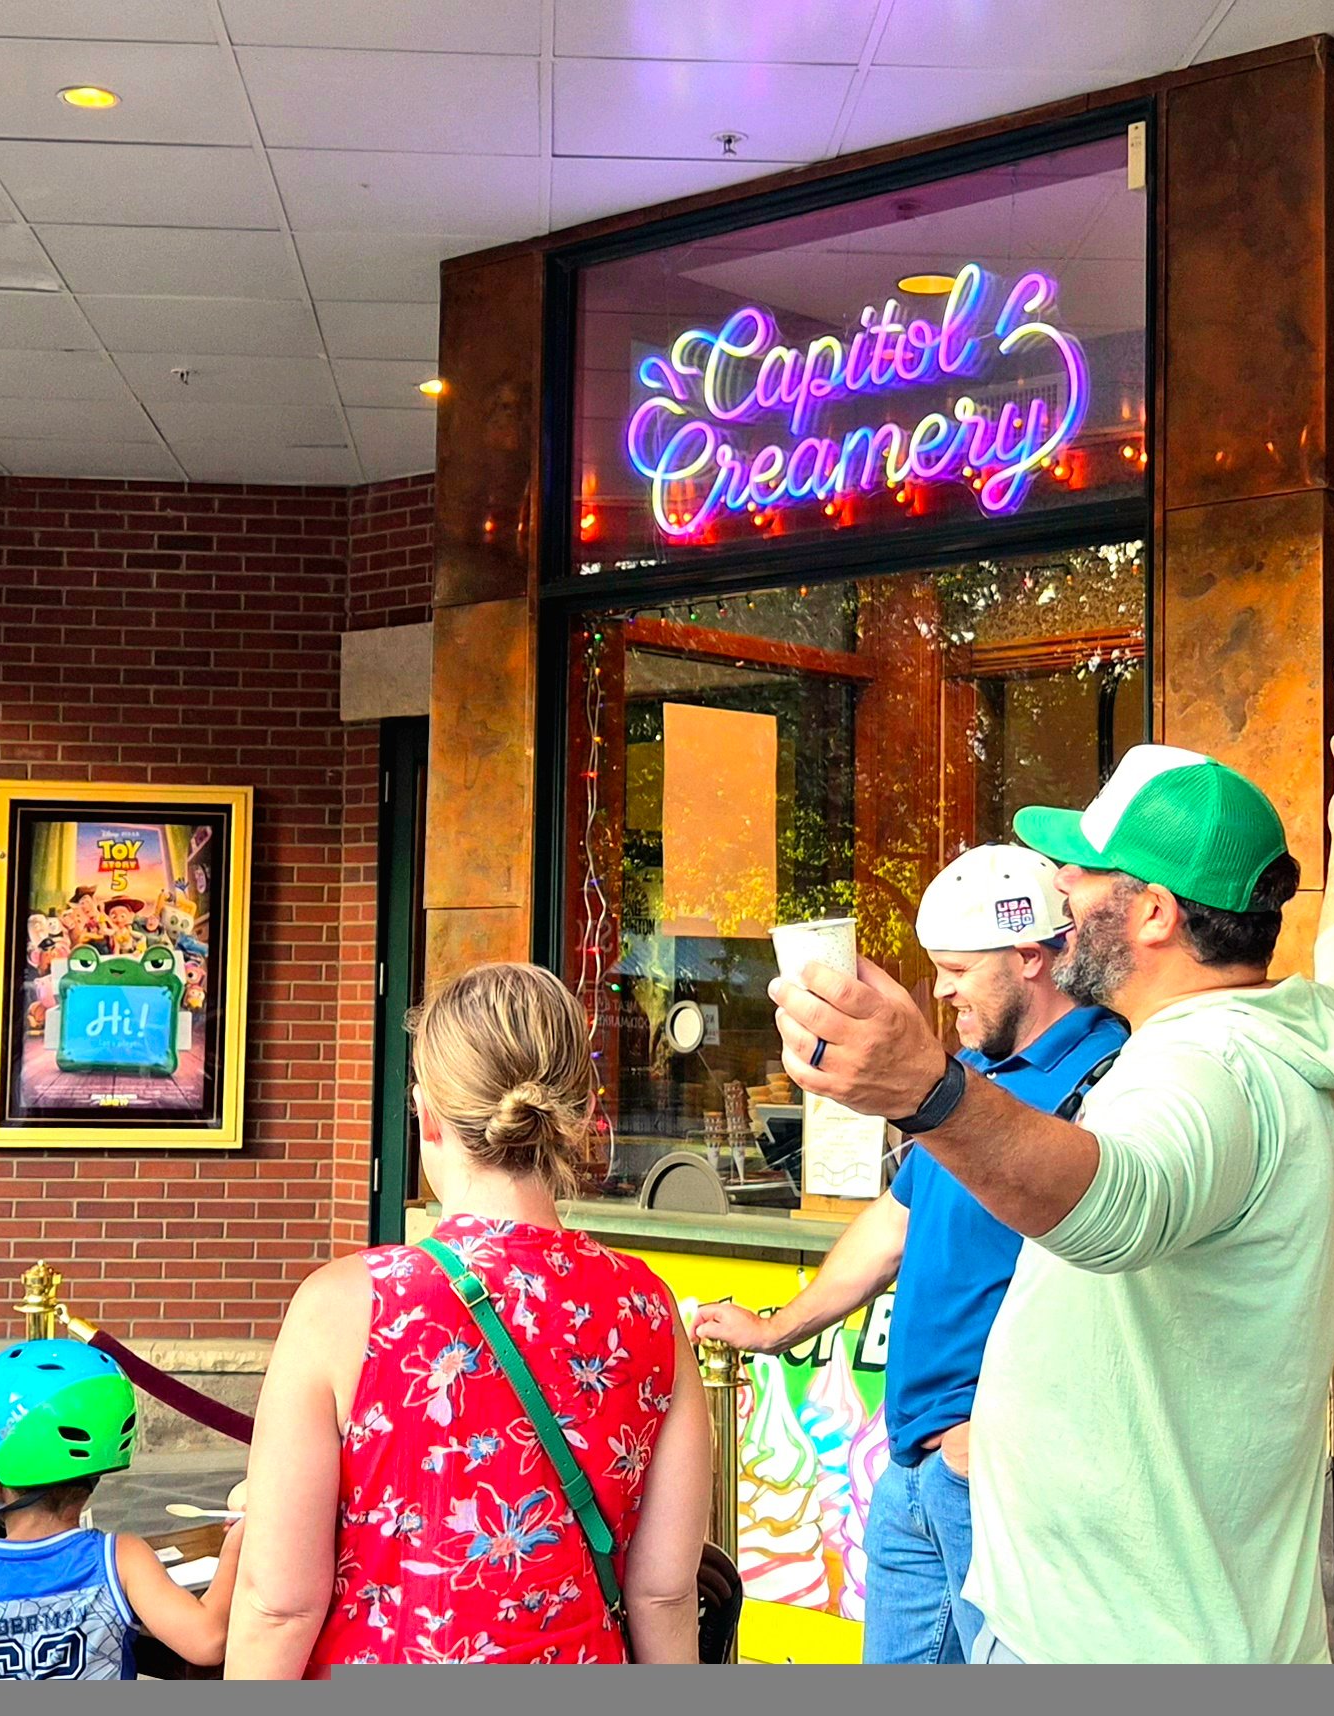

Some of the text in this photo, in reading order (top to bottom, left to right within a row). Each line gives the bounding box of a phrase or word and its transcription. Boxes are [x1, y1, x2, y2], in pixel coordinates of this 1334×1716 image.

[670, 263, 981, 434] Capitol
[628, 362, 1077, 535] Creamery
[97, 839, 144, 861] TOY
[111, 869, 128, 891] 5
[998, 899, 1030, 912] USA
[998, 914, 1033, 928] 250
[86, 1000, 149, 1038] Hi!
